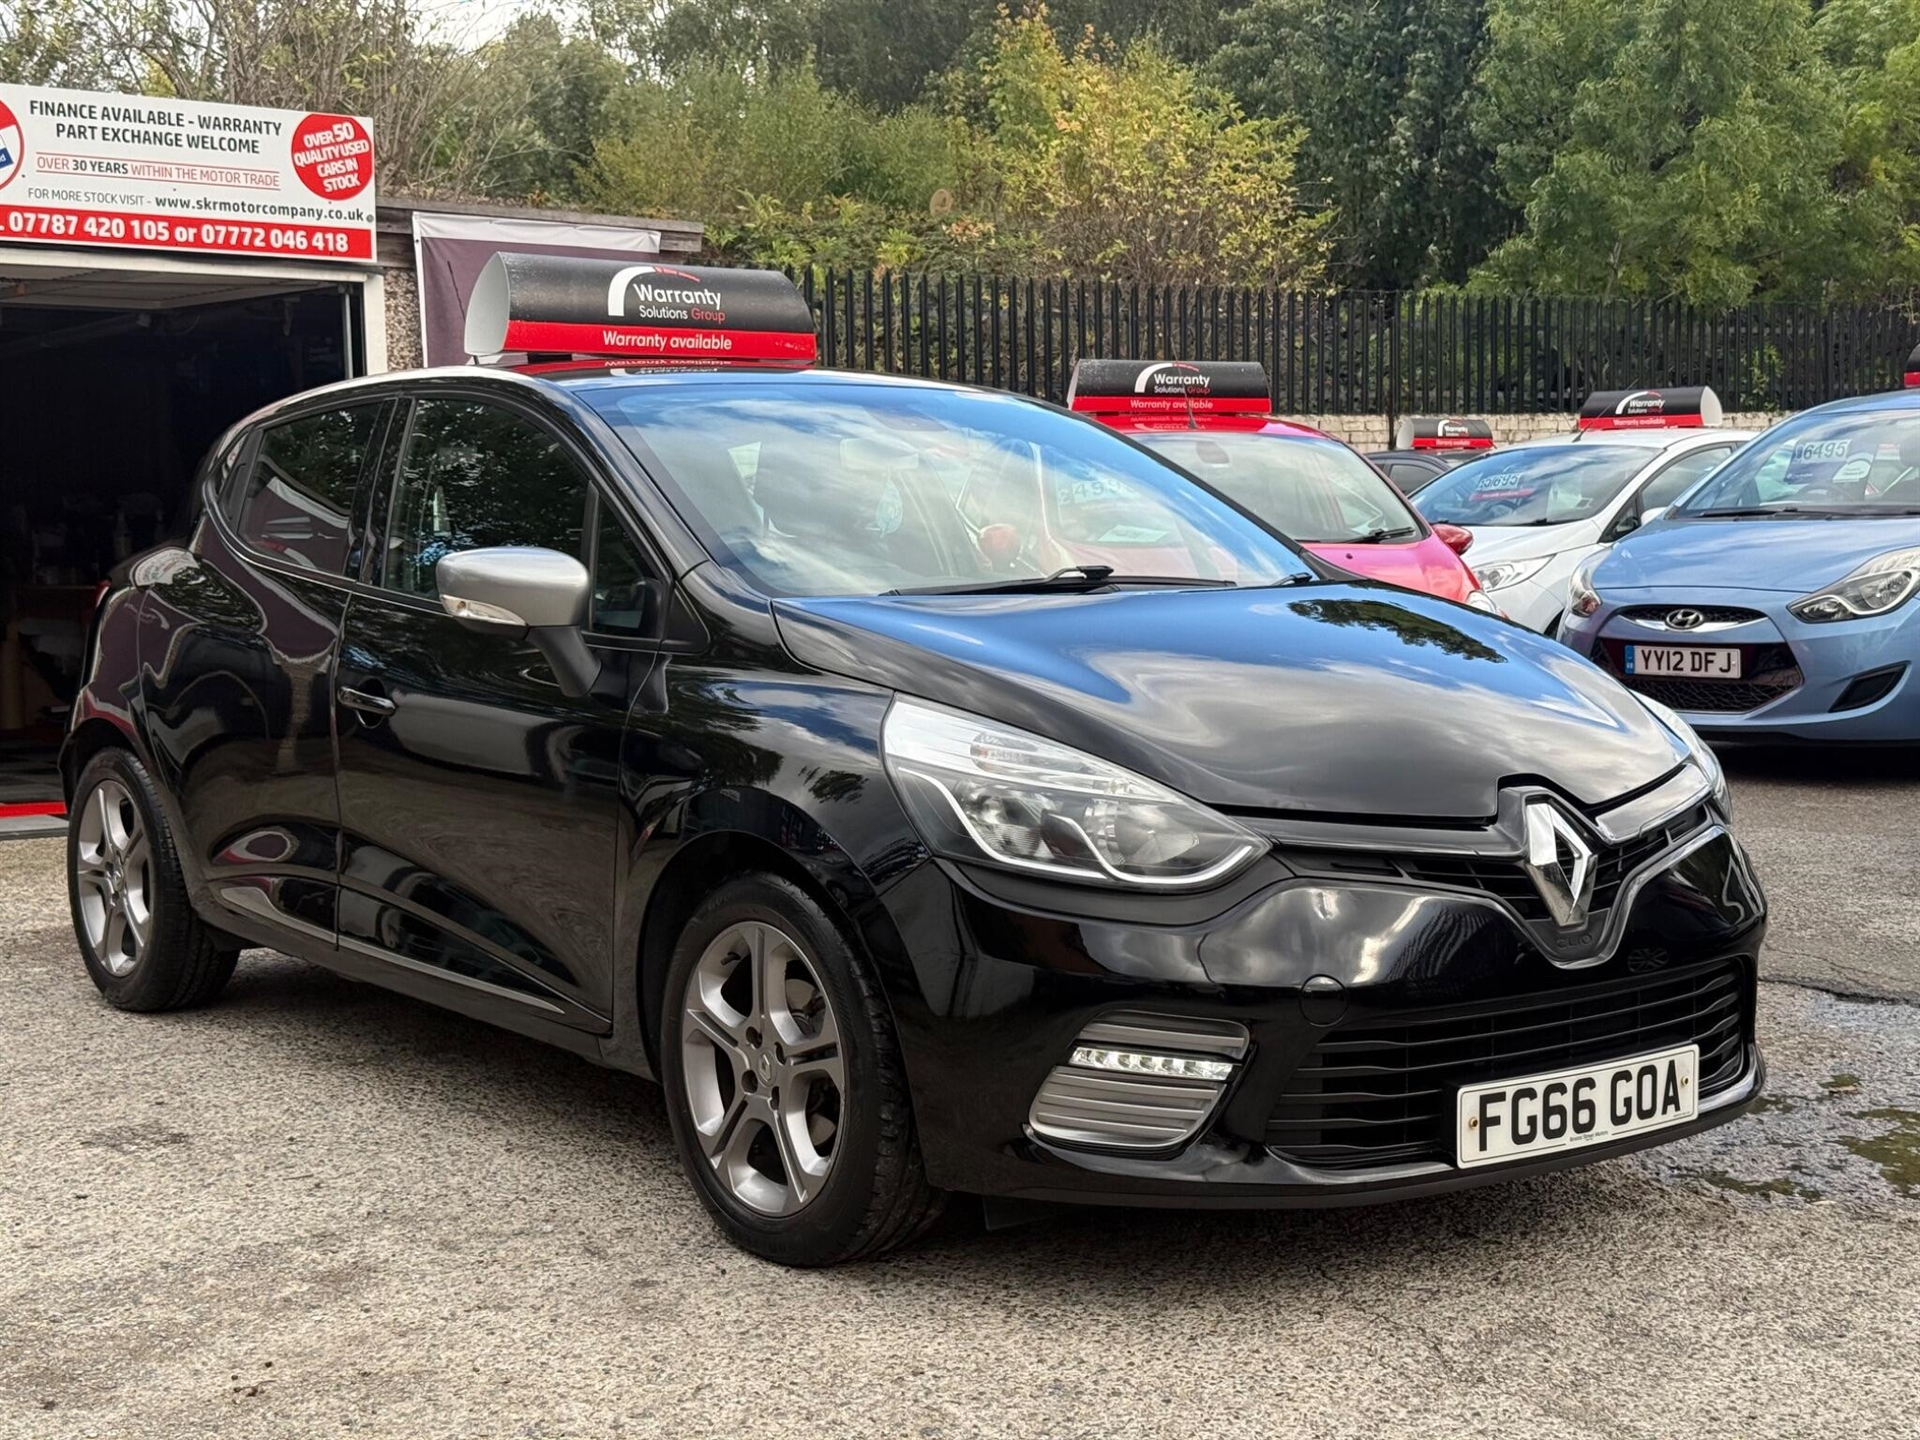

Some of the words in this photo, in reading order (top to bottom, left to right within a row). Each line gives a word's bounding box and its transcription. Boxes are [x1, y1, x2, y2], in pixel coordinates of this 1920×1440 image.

[30, 100, 97, 120] FINANCE
[101, 106, 185, 127] AVAILABLE
[197, 115, 282, 136] WARRANTY
[56, 123, 98, 140] PART
[102, 127, 183, 147] EXCHANGE
[186, 134, 260, 154] WELCOME
[303, 130, 335, 148] OVER
[332, 122, 355, 142] 50
[294, 145, 340, 167] QUALITY
[340, 139, 370, 157] USED
[37, 156, 70, 170] OVER
[72, 159, 87, 171] 30
[89, 160, 129, 174] YEARS
[131, 164, 173, 178] WITHIN
[175, 167, 198, 180] THE
[200, 170, 241, 184] MOTOR
[243, 173, 280, 187] TRADE
[316, 160, 346, 177] CARS
[345, 157, 359, 172] IN
[323, 173, 361, 192] STOCK
[28, 187, 50, 200] FOR
[52, 189, 82, 202] MORE
[84, 191, 119, 204] STOCK
[119, 194, 145, 206] VISIT
[155, 197, 364, 222] www.skrmotorcompany.co.uk
[9, 211, 78, 235] 07787
[83, 216, 126, 238] 420
[130, 219, 170, 241] 105
[174, 226, 198, 243] or
[201, 224, 266, 247] 07772
[270, 229, 308, 250] 046
[311, 232, 349, 252] 418
[633, 283, 721, 310] Warranty
[639, 305, 688, 320] Solutions
[691, 308, 726, 324] Group
[603, 330, 667, 352] Warranty
[669, 333, 733, 350] available
[1153, 373, 1210, 388] Warranty
[1187, 386, 1211, 395] Group
[1130, 400, 1171, 410] Warranty
[1629, 399, 1666, 409] Warranty
[1641, 650, 1684, 672] YY12
[1690, 651, 1732, 673] DFJ
[1557, 934, 1593, 948] CLIO
[1479, 1077, 1597, 1152] FG66
[1610, 1059, 1681, 1126] GOA
